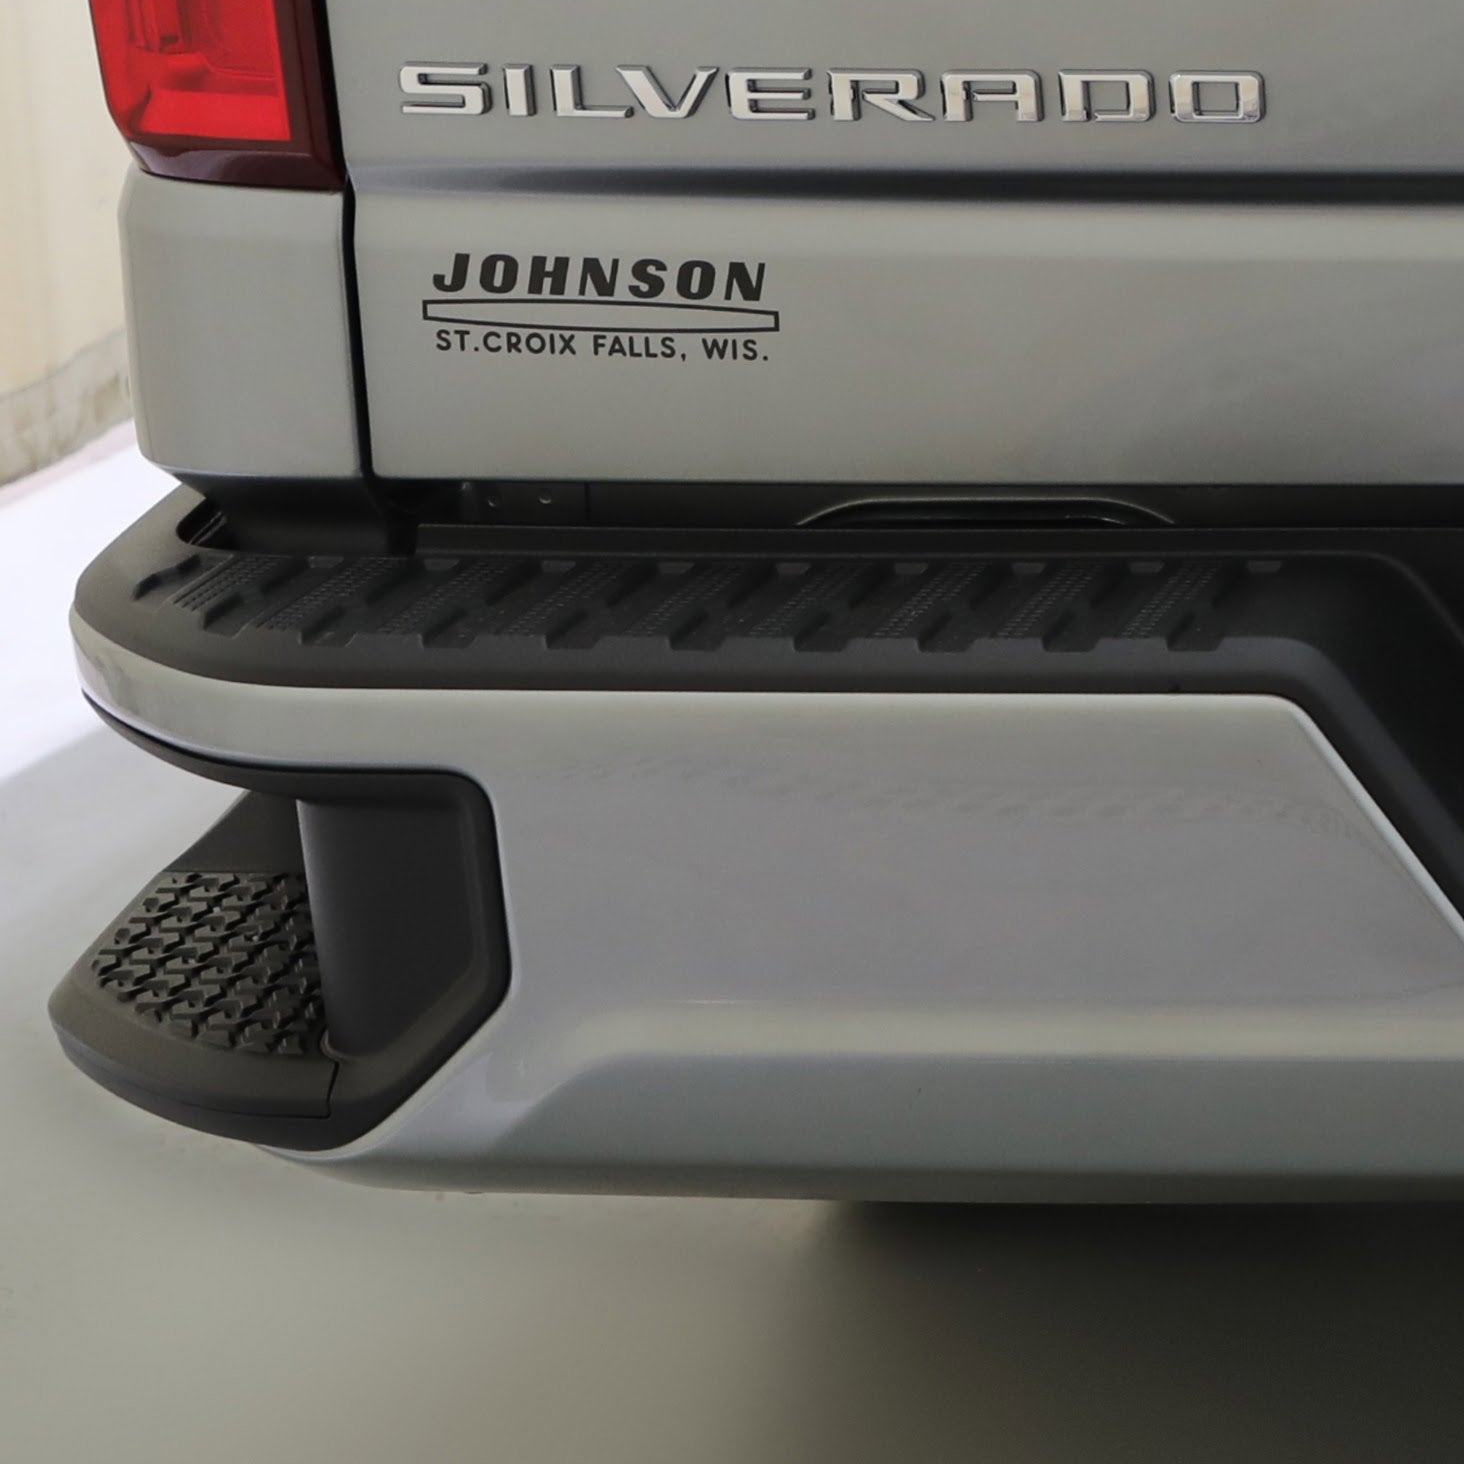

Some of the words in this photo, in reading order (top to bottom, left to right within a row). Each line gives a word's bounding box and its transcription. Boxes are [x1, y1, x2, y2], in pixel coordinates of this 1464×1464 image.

[398, 61, 1268, 124] SILVERADO
[432, 252, 767, 303] JOHNSON
[592, 334, 688, 364] FALLS,
[701, 337, 770, 363] WIS.
